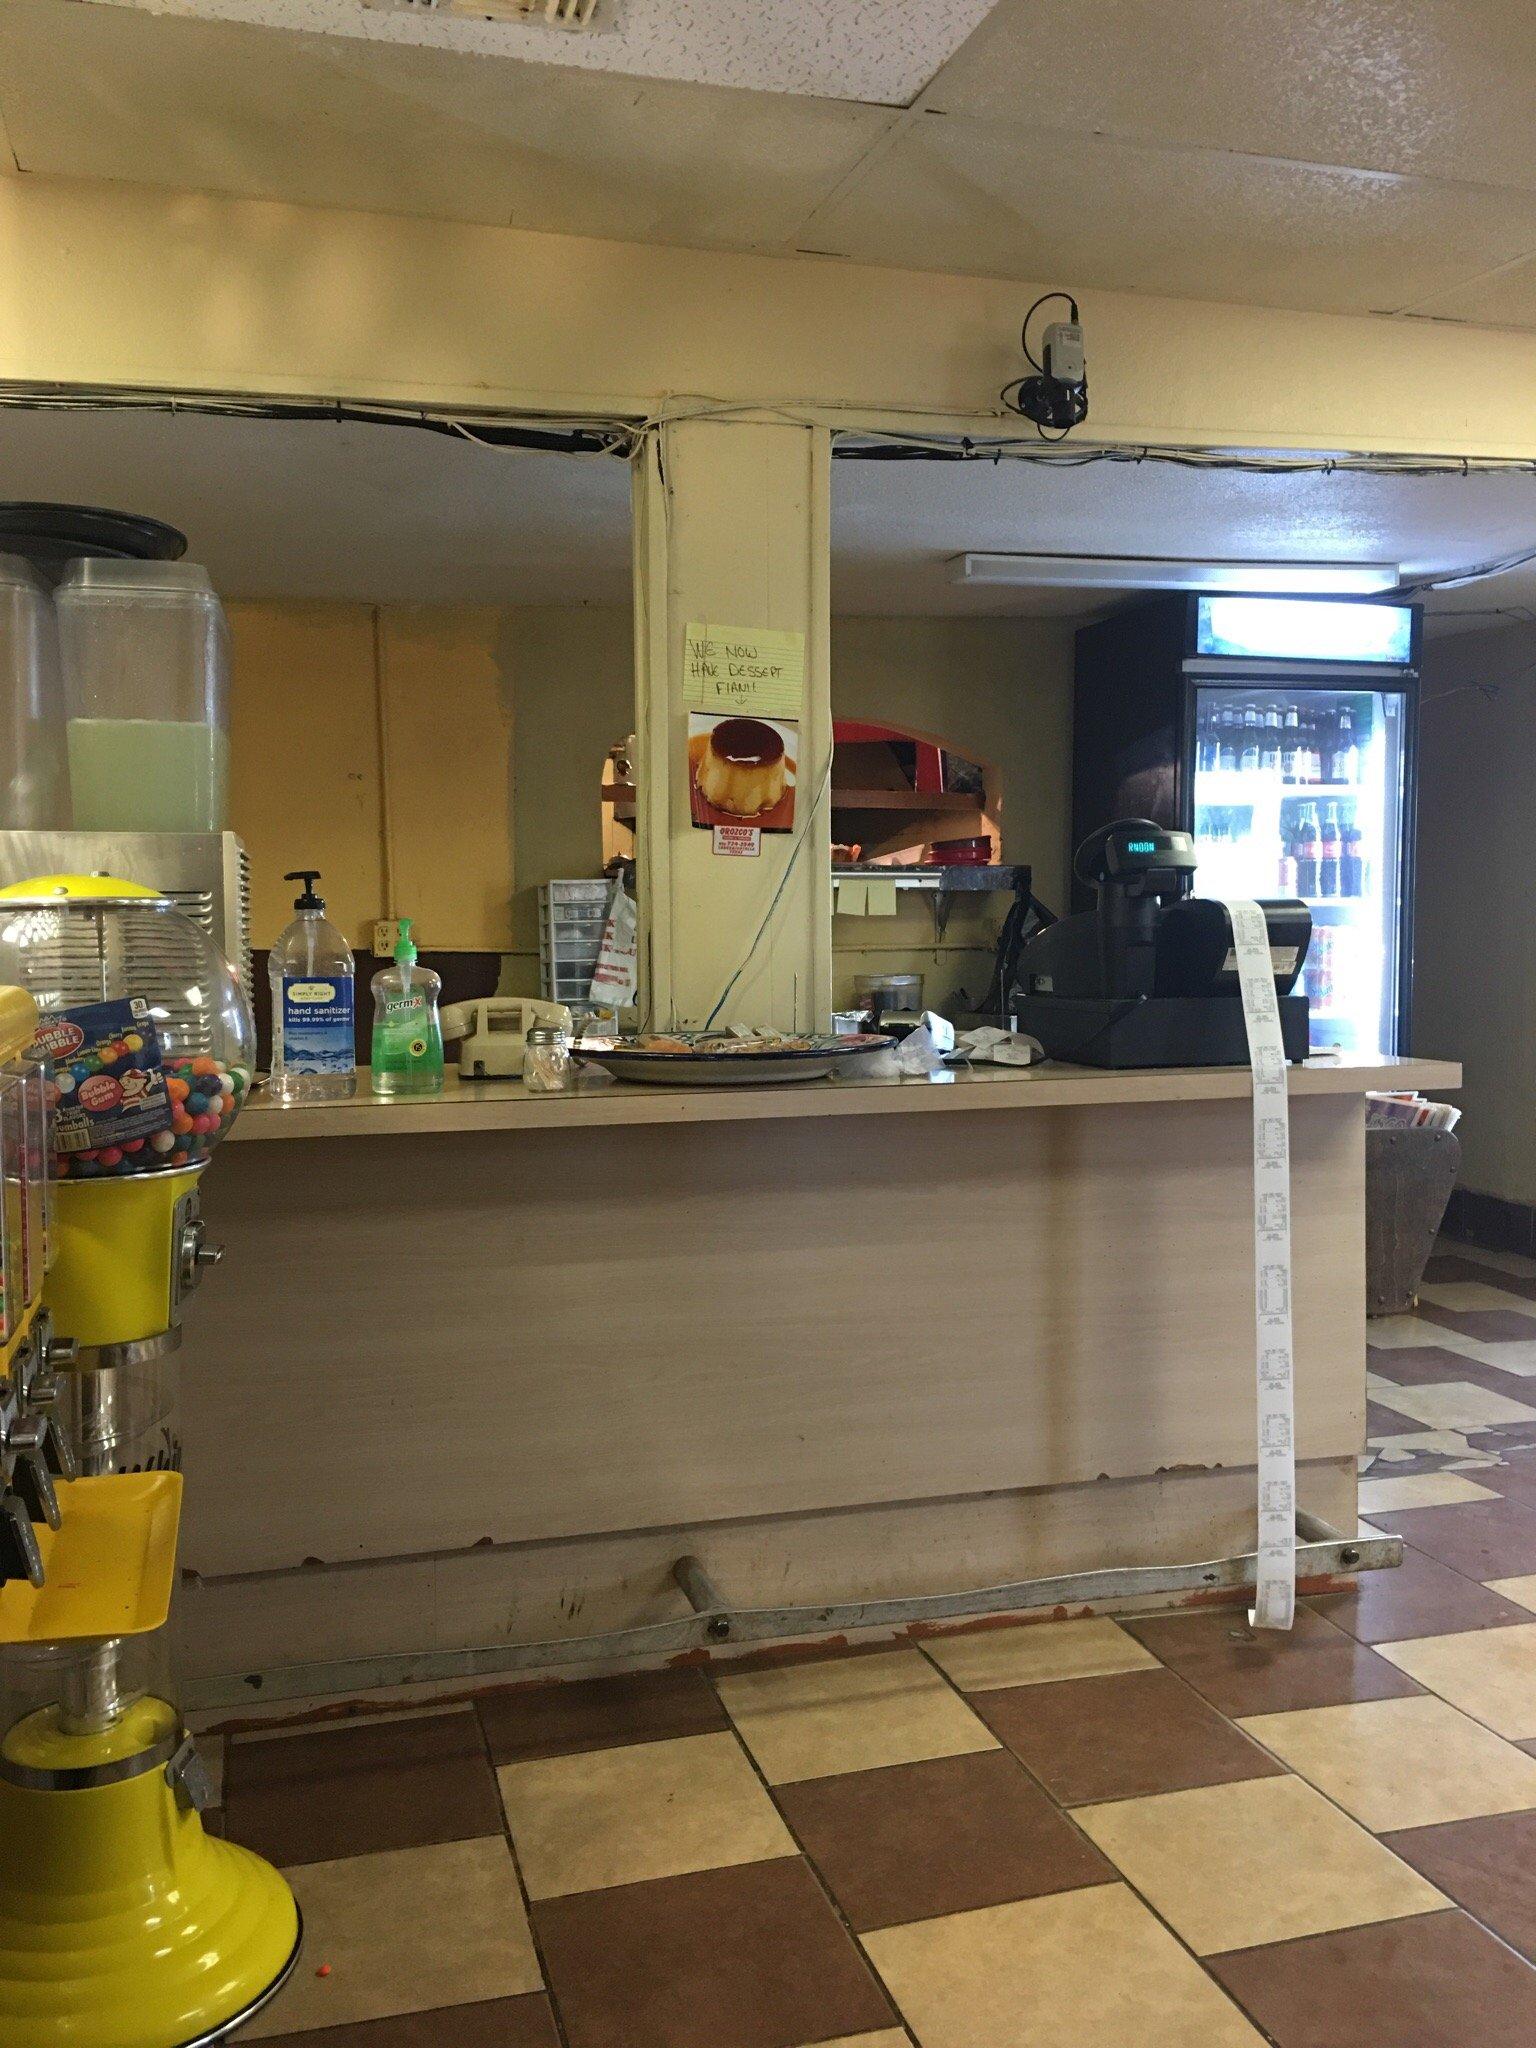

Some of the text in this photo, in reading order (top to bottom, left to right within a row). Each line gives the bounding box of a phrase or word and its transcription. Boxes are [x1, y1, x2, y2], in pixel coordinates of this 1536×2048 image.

[688, 639, 758, 659] WE NOW
[691, 662, 719, 677] HAVE
[720, 828, 754, 836] OROZCO'S
[134, 1001, 143, 1010] 30
[288, 1006, 351, 1015] hand sanitizer
[81, 1081, 116, 1100] Bubble
[90, 1092, 114, 1106] Gum
